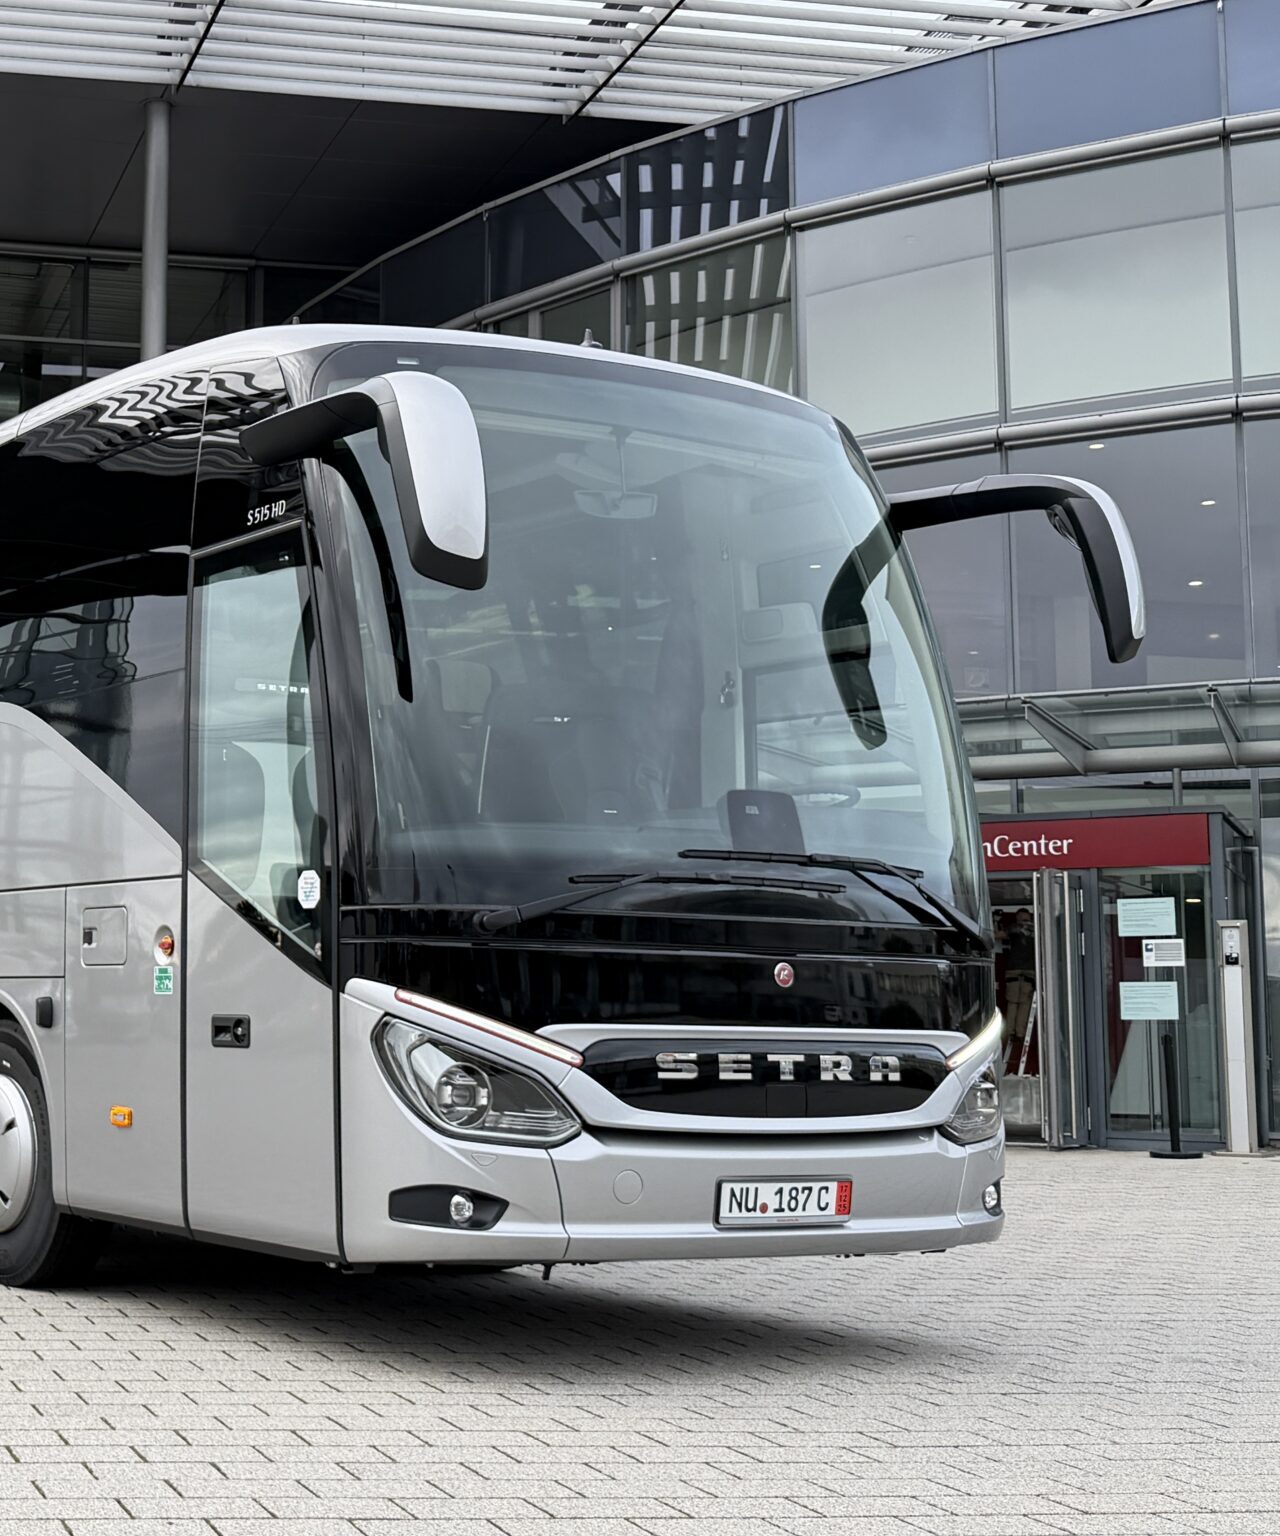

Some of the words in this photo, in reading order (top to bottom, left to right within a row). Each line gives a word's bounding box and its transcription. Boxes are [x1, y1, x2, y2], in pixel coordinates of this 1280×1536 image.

[246, 509, 254, 526] S
[254, 504, 270, 524] 515
[271, 499, 286, 518] HD
[655, 1052, 901, 1082] SETRA
[728, 1186, 759, 1213] NU
[773, 1186, 813, 1213] 187
[817, 1186, 829, 1211] C
